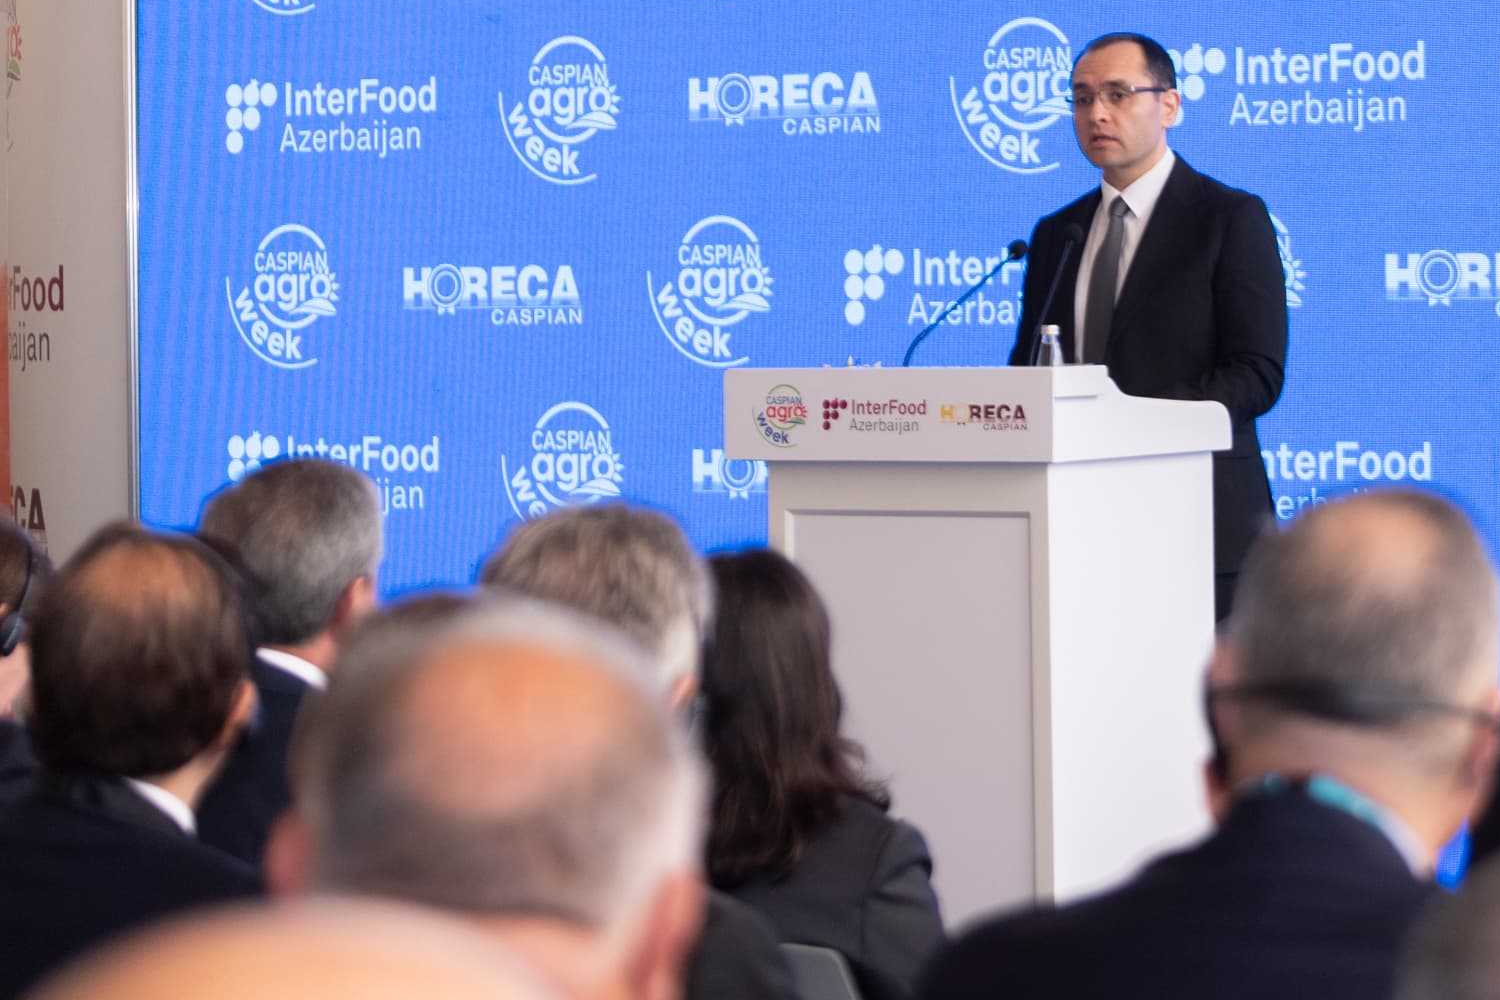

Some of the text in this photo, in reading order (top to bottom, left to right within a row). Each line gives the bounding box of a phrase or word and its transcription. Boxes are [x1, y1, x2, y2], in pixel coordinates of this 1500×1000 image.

[528, 63, 607, 88] CASPIAN
[983, 46, 1071, 70] CASPIAN
[1234, 41, 1425, 85] InterFood
[284, 76, 436, 116] InterFood
[528, 86, 611, 126] agro
[688, 72, 878, 122] HORECA
[1229, 90, 1406, 132] Azerbaijan
[280, 122, 421, 157] Azerbaijan
[508, 103, 580, 175] week
[782, 116, 880, 136] CASPIAN
[961, 86, 1040, 164] week
[254, 251, 327, 273] CASPIAN
[679, 243, 761, 266] CASPIAN
[913, 247, 1027, 285] InterF
[254, 270, 331, 310] agro
[403, 264, 580, 309] HORECA
[679, 263, 765, 307] agro
[234, 287, 302, 360] week
[490, 309, 582, 325] CASPIAN
[657, 282, 731, 359] week
[907, 291, 1023, 325] Azerbai
[766, 396, 802, 405] CASPIAN
[766, 404, 800, 423] agro
[851, 400, 926, 416] InterFood
[940, 404, 1027, 423] HORECA
[531, 430, 610, 453] CASPIAN
[757, 413, 790, 444] week
[850, 418, 919, 435] Azerbaijan
[983, 422, 1027, 431] CASPIAN
[531, 452, 614, 493] agro
[1261, 442, 1432, 481] nterFood
